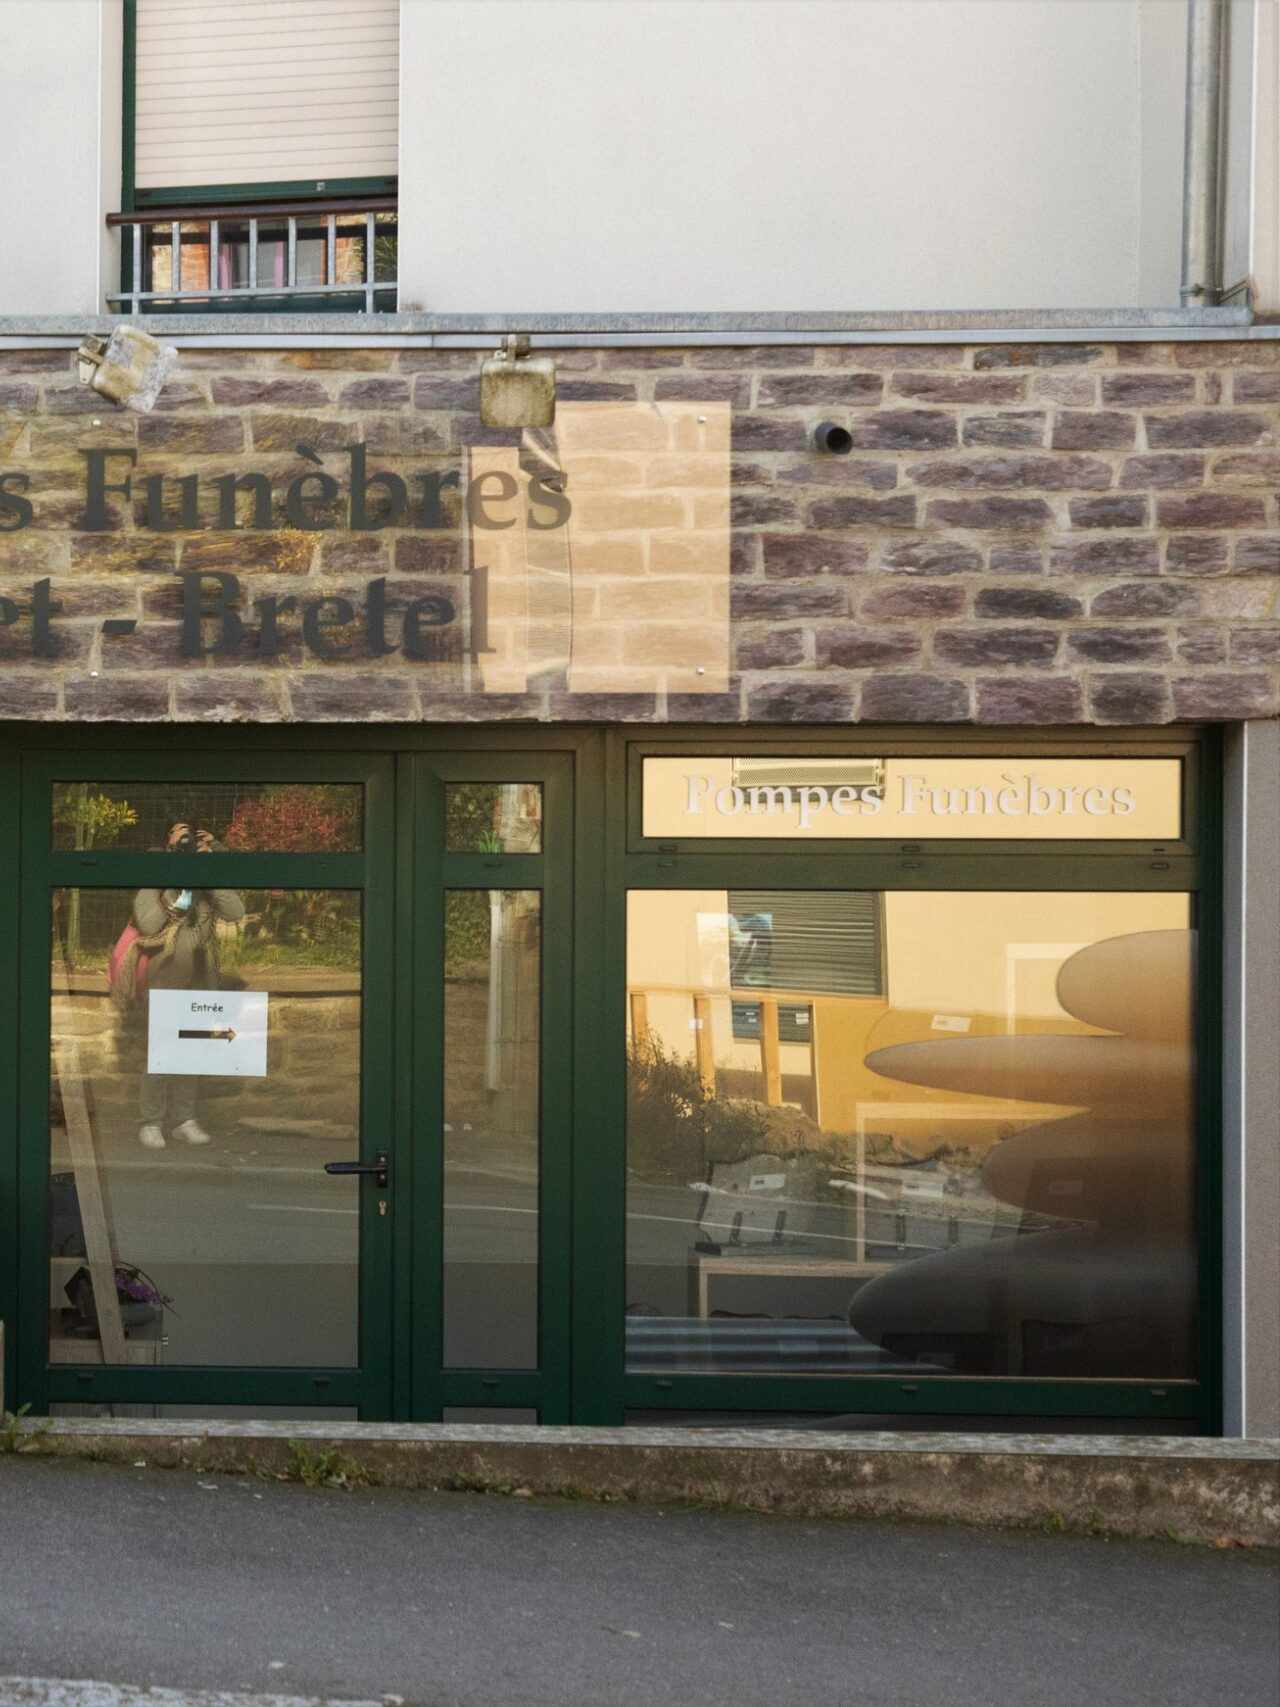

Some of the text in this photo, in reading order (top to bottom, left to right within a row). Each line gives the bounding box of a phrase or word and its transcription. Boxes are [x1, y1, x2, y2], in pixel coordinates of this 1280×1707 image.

[78, 444, 572, 531] Funèbres
[175, 566, 497, 659] Bretel
[683, 772, 1136, 828] Pompes Funèbres
[190, 1002, 224, 1013] Entrée
